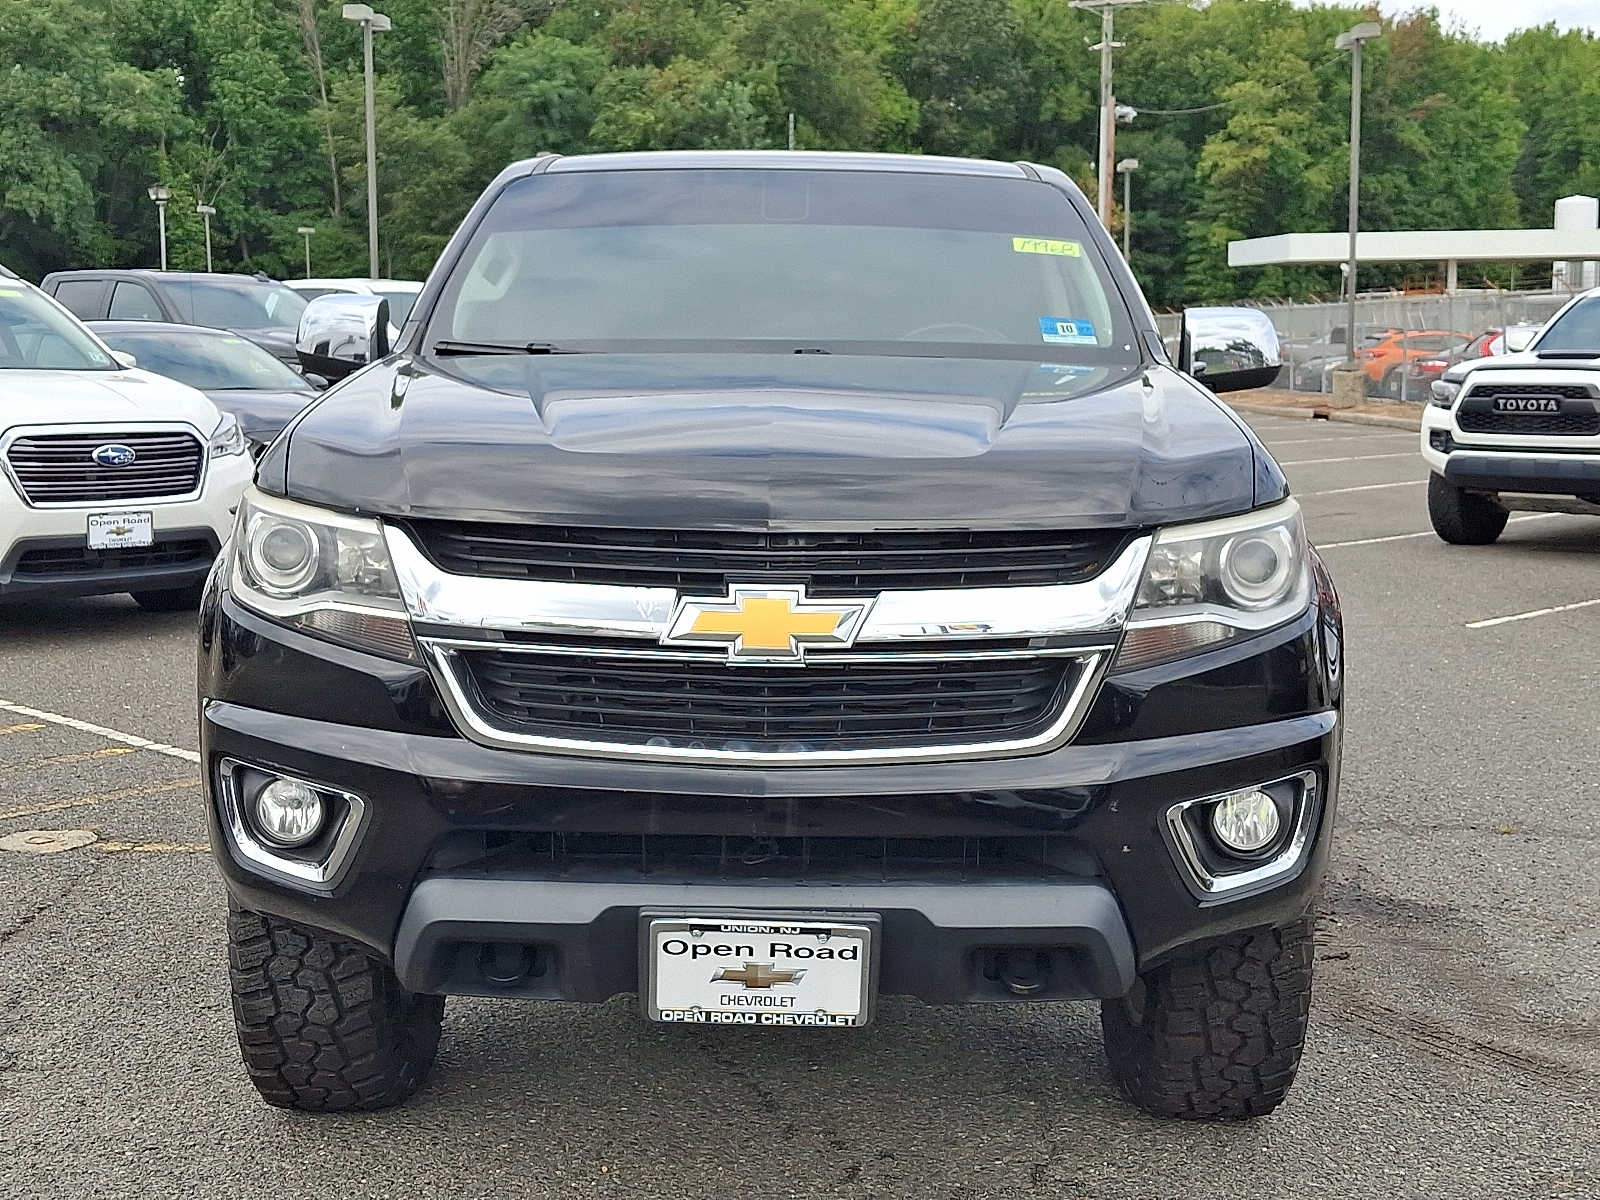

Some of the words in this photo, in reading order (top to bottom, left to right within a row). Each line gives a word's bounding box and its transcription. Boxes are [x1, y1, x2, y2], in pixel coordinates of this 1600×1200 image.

[1497, 398, 1558, 411] TOYOTA
[90, 519, 120, 527] Open
[780, 926, 801, 935] NJ
[662, 939, 754, 960] Open
[769, 942, 859, 961] Road
[720, 994, 797, 1008] CHEVROLET
[661, 1010, 706, 1023] OPEN
[710, 1011, 757, 1024] ROAD
[760, 1012, 856, 1026] CHEVROLET
